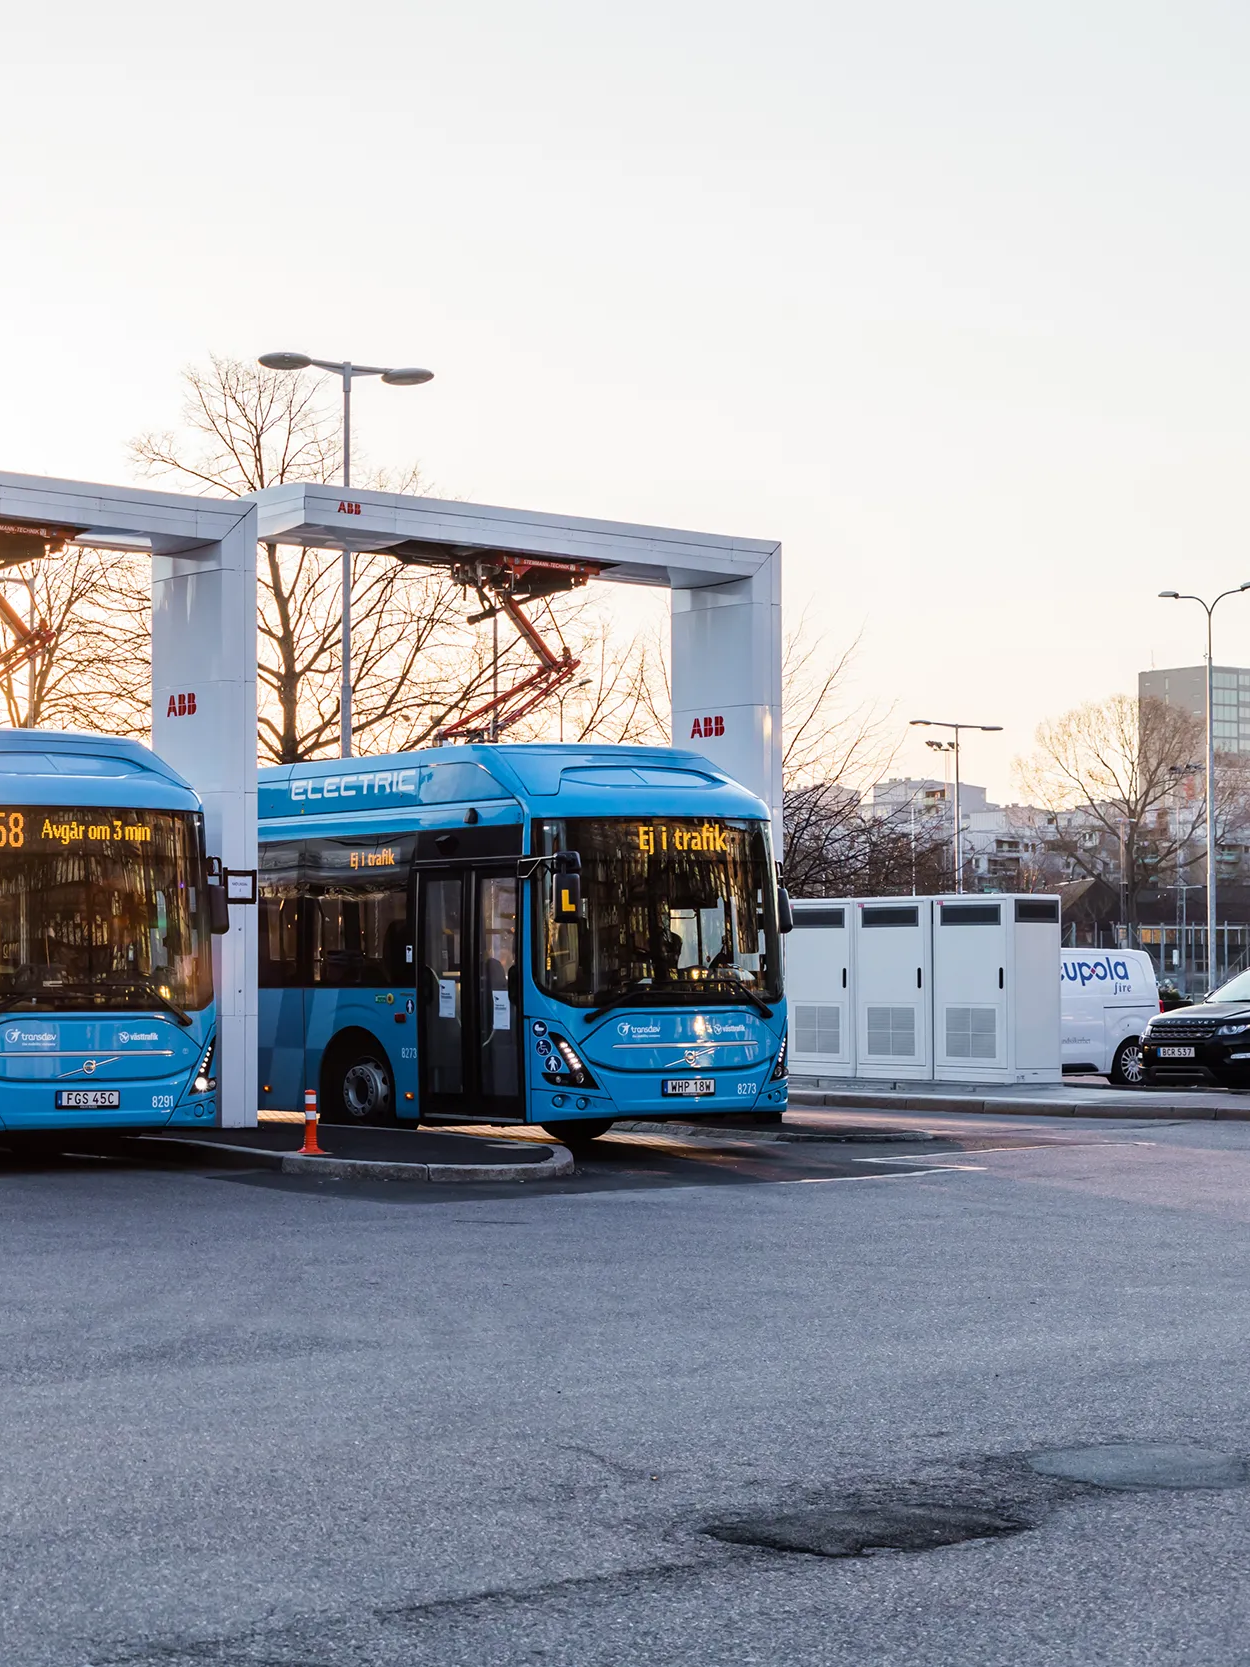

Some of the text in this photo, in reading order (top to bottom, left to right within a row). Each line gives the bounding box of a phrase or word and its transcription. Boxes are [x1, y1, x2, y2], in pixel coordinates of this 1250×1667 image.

[337, 501, 361, 515] ABB
[167, 692, 197, 717] ABB
[690, 715, 725, 739] ABB
[291, 769, 416, 801] ELECTRIC
[41, 818, 84, 845] Avgår
[88, 824, 111, 840] om
[113, 820, 122, 841] 3
[125, 823, 151, 841] min
[638, 823, 728, 855] Ej i trafik
[350, 848, 395, 870] Ej i trafik
[1114, 981, 1132, 995] fire
[631, 1025, 660, 1033] transdev
[21, 1032, 57, 1041] transdev
[130, 1032, 159, 1041] västtrafik
[401, 1047, 417, 1059] 8273
[1162, 1048, 1192, 1056] BCR 537
[671, 1081, 711, 1092] WHP 18W
[737, 1083, 757, 1095] 8273
[67, 1092, 115, 1105] FGS 45C
[151, 1095, 174, 1108] 8291
